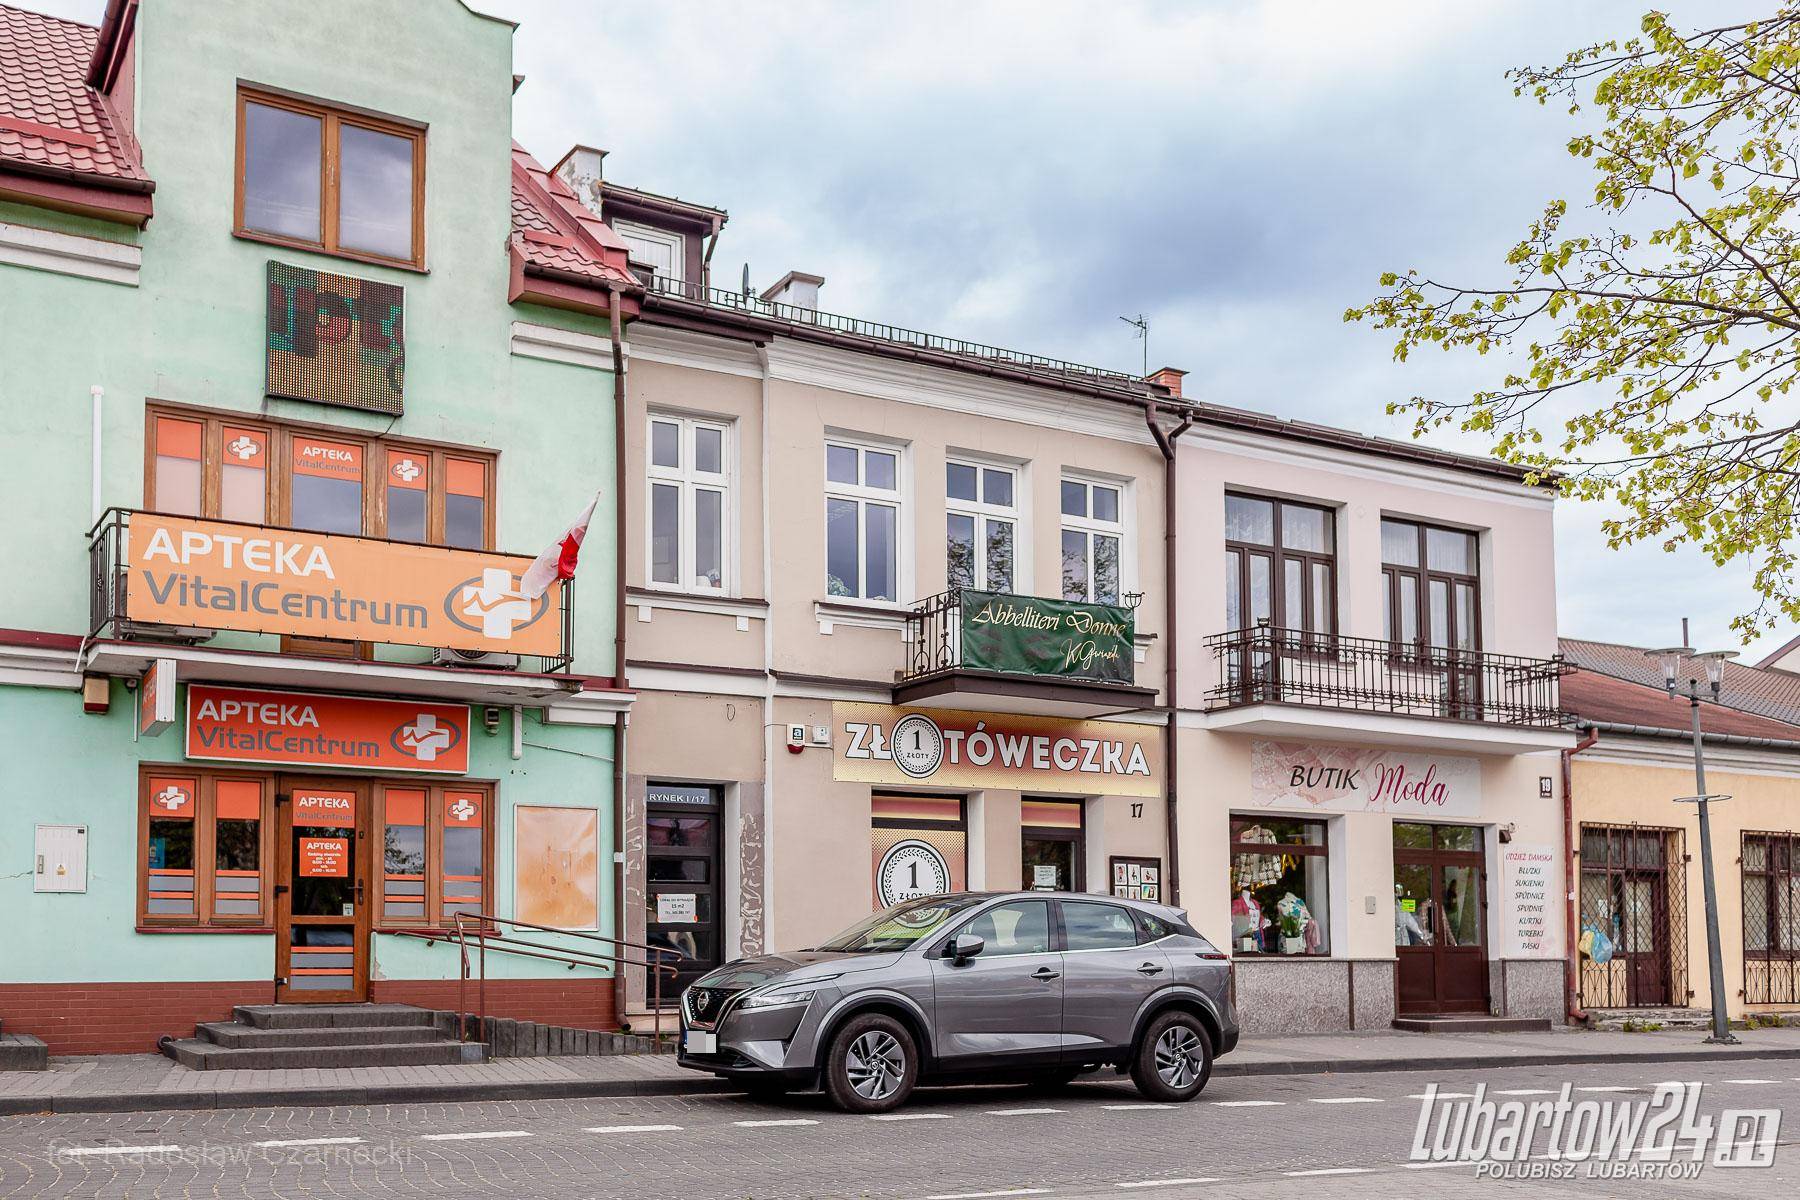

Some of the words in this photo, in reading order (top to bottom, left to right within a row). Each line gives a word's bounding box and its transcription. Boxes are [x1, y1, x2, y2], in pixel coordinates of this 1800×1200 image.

[302, 446, 353, 462] APTEKA
[143, 527, 335, 580] APTEKA
[142, 570, 428, 629] VitalCentrum
[972, 600, 1061, 631] Abbellitevi
[1066, 610, 1126, 637] Donne
[196, 699, 319, 728] APTEKA
[197, 726, 380, 758] VitalCentrum
[912, 729, 921, 750] 1
[906, 752, 930, 760] ZŁOTY
[1290, 765, 1361, 791] BUTIK
[1370, 763, 1450, 807] Moda
[298, 796, 350, 809] APTEKA
[649, 793, 684, 802] RYNEK
[1130, 802, 1144, 819] 17
[306, 842, 343, 850] APTEKA
[907, 860, 919, 889] 1
[1518, 917, 1543, 925] KURTKI
